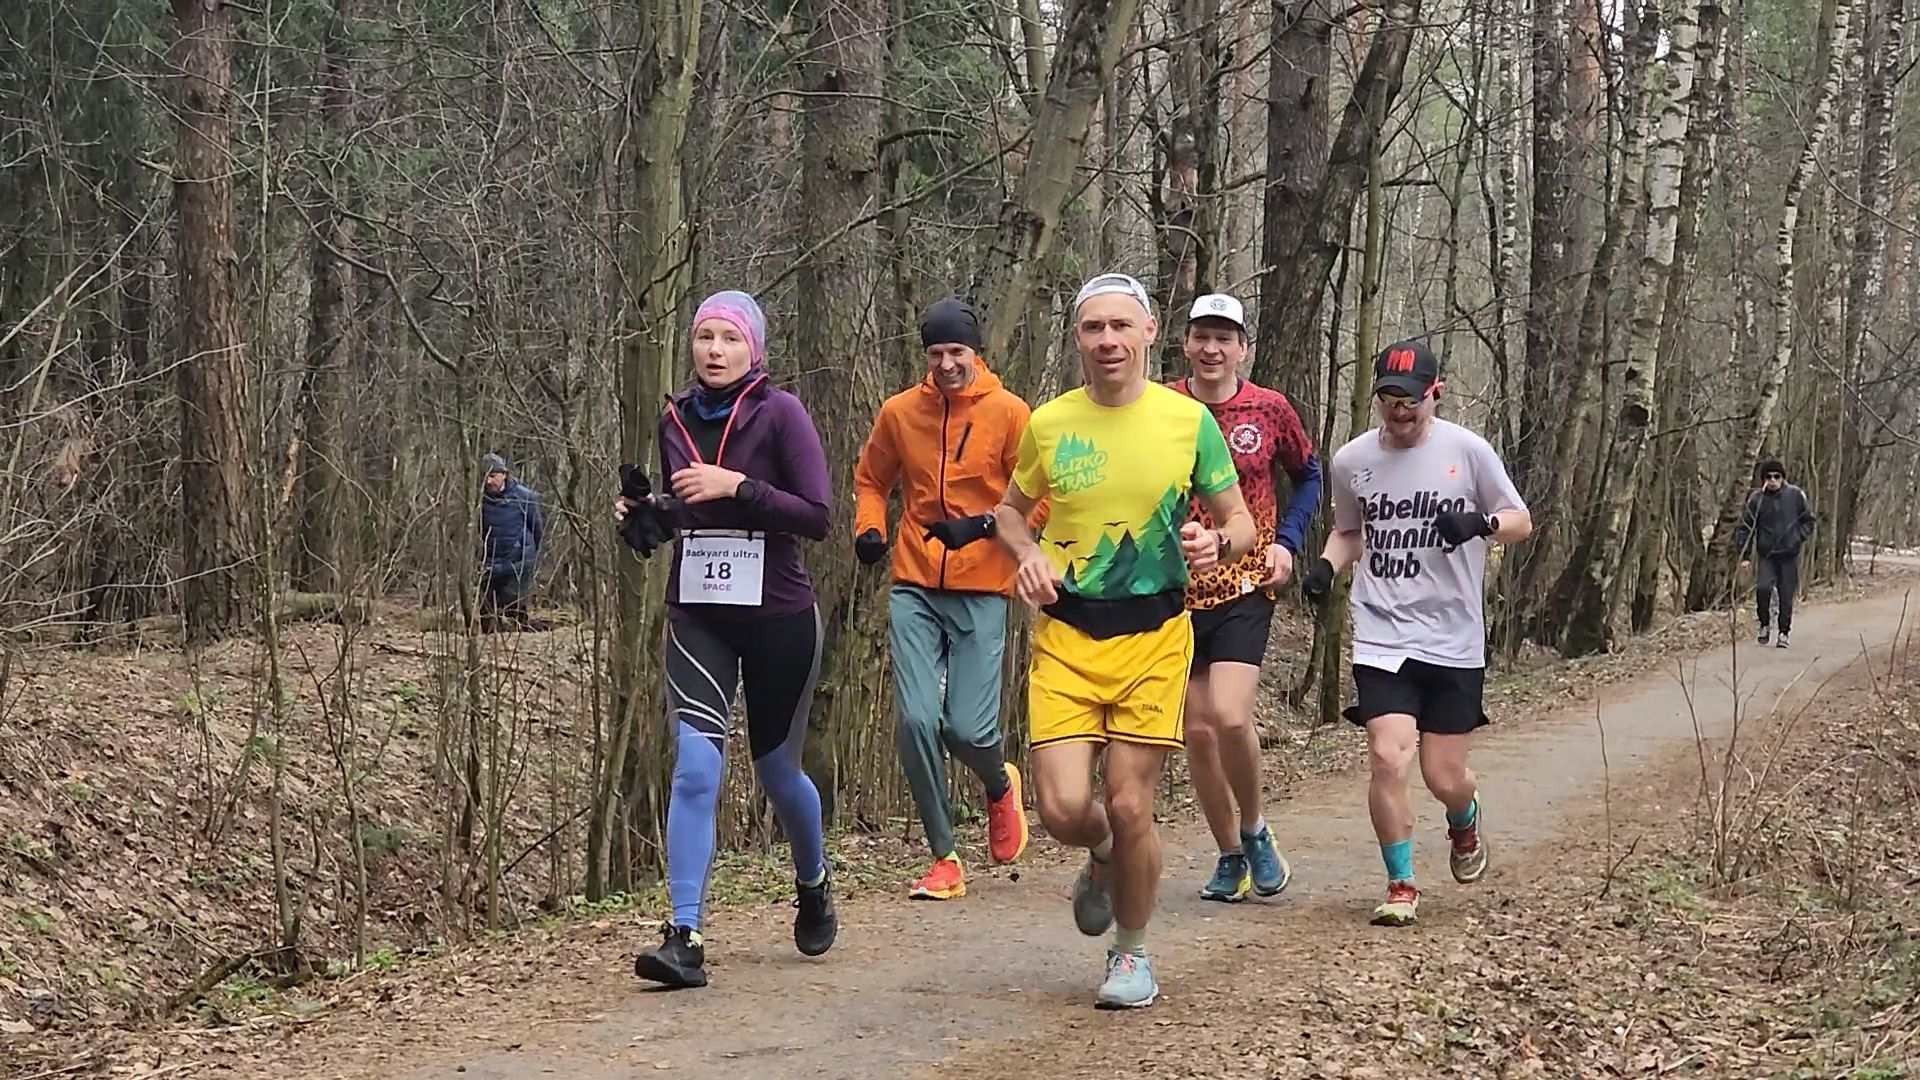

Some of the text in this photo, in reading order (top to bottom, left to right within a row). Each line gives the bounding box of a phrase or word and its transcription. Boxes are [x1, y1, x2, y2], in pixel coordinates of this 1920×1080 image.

[1050, 451, 1107, 481] BLIZKO
[1057, 470, 1106, 494] TRAIL
[686, 549, 759, 559] Backyard ultra
[704, 561, 731, 579] 18
[1370, 551, 1420, 579] Club
[702, 583, 732, 592] SPACE
